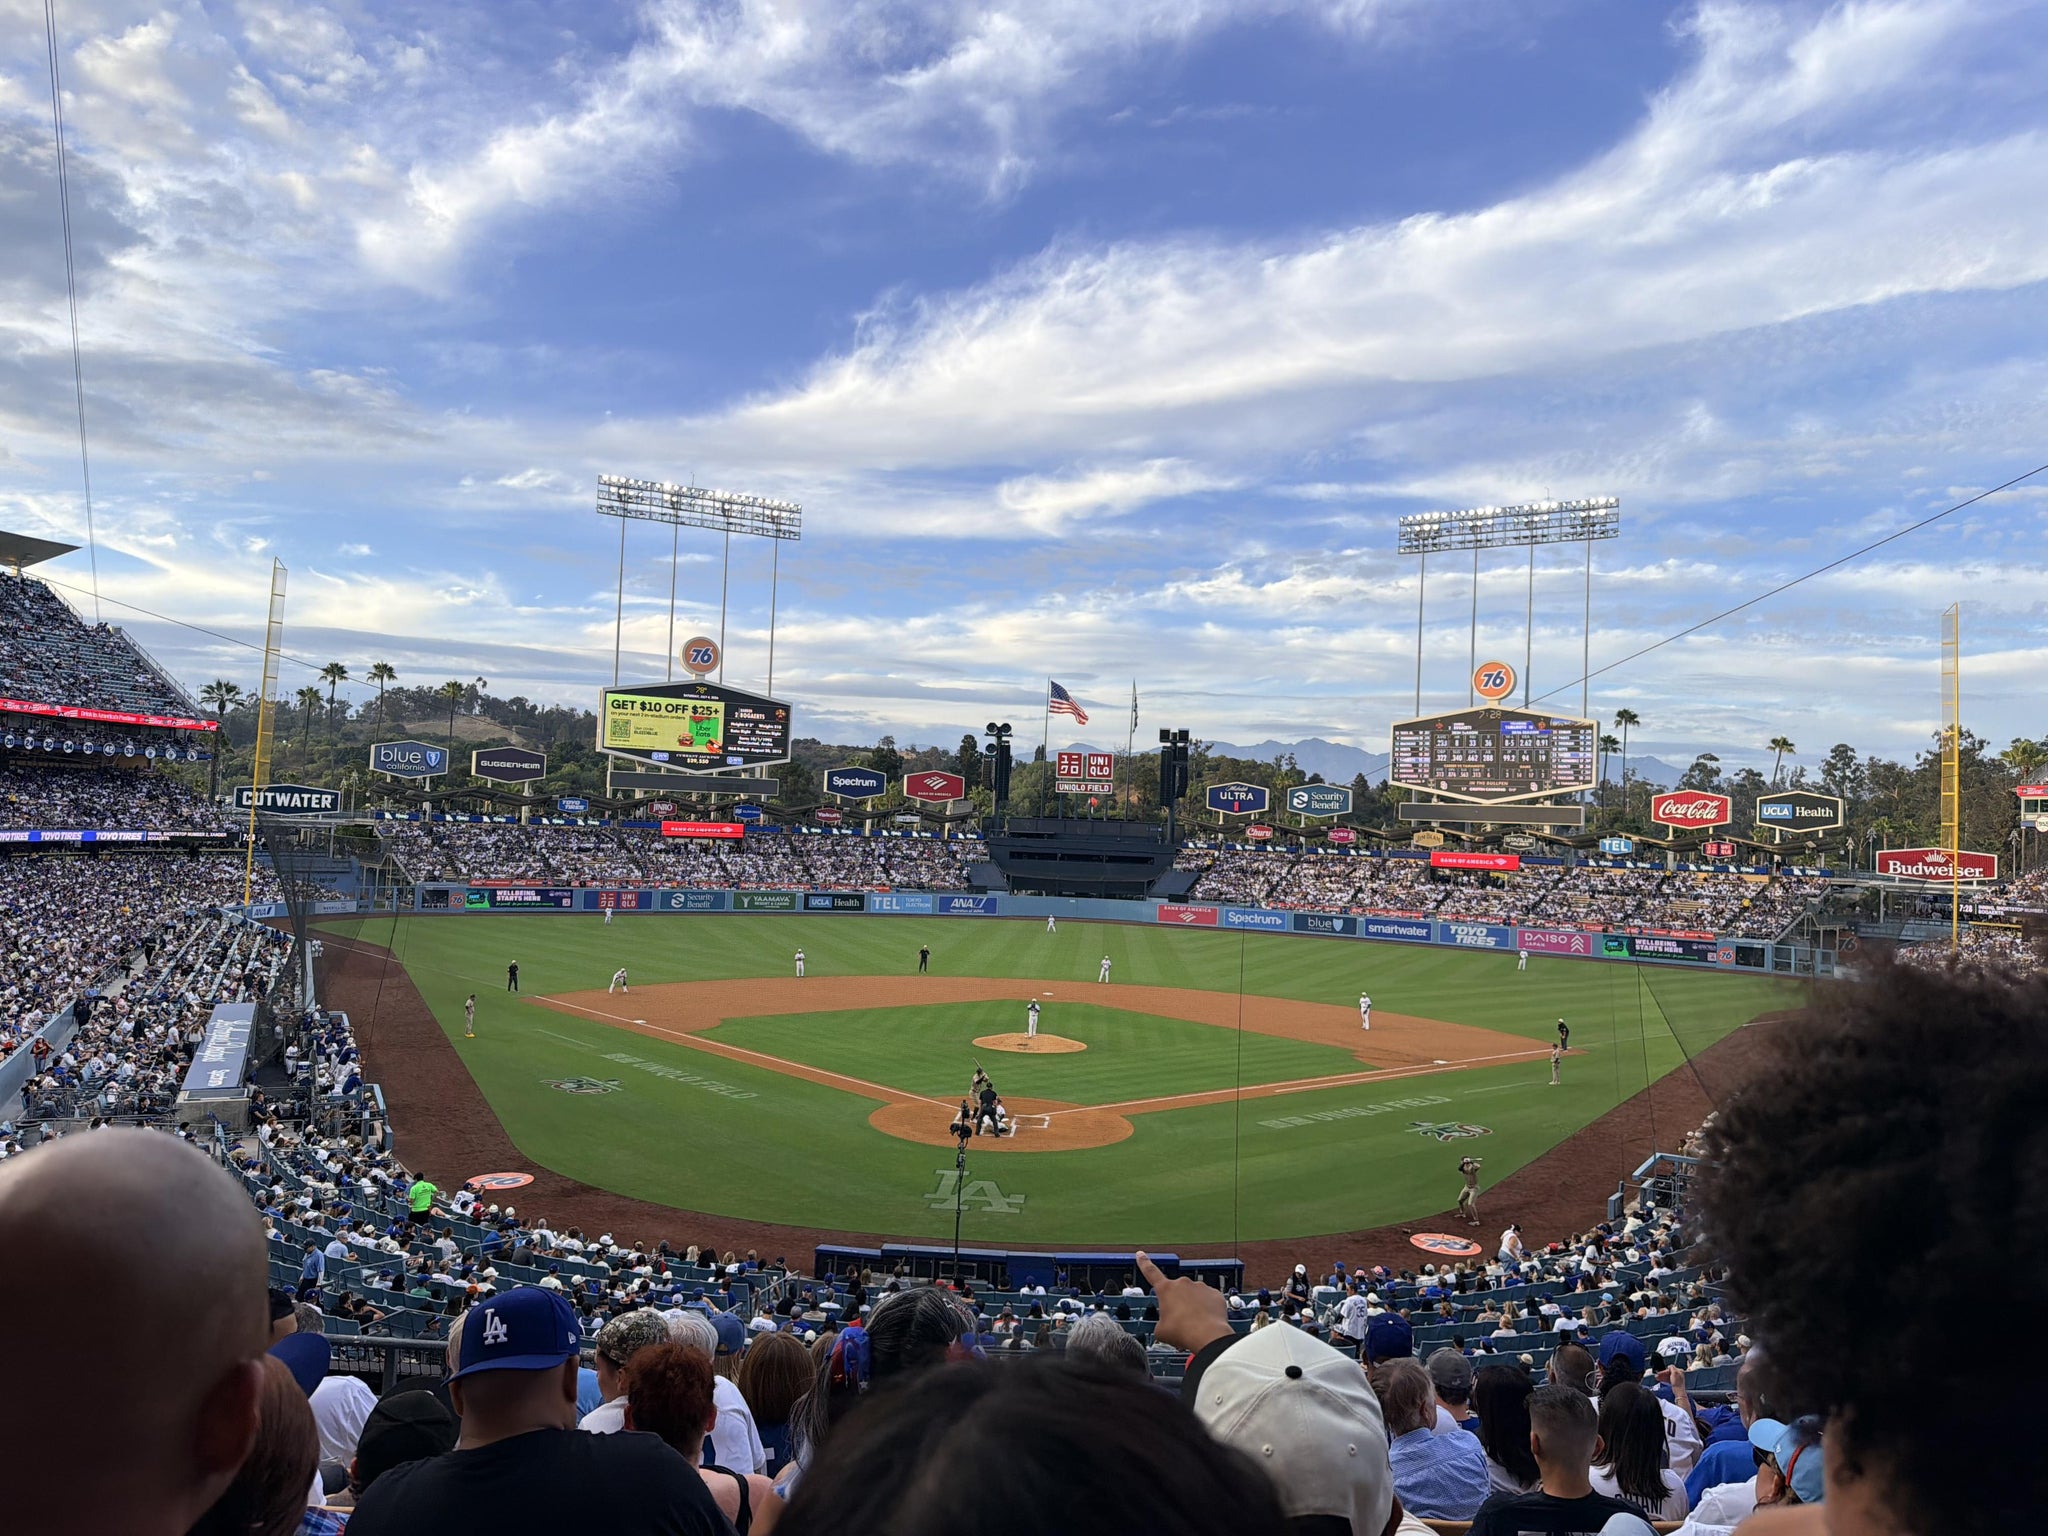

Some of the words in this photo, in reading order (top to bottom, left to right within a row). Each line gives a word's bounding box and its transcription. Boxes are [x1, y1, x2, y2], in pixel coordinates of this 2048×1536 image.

[690, 647, 713, 665] 76
[1480, 669, 1506, 689] 76
[612, 700, 636, 710] GET
[640, 701, 662, 712] $10
[665, 704, 688, 714] OFF
[692, 705, 719, 716] $25+
[1479, 710, 1501, 719] 7:28
[26, 738, 34, 747] 24
[105, 744, 114, 754] 42
[126, 747, 134, 755] 53
[380, 747, 422, 762] blue
[481, 760, 540, 769] GUGGENHEIM
[1091, 756, 1108, 765] UNI
[386, 762, 426, 772] california
[1090, 767, 1109, 776] QLO
[832, 776, 877, 788] Spectrum
[242, 791, 332, 808] CUTWATER
[1220, 792, 1254, 800] ULTRA
[1312, 792, 1344, 803] Security
[653, 803, 672, 812] JINRO
[1312, 801, 1341, 810] Benefit
[1659, 800, 1720, 820] Coca-Cola
[1763, 806, 1789, 816] UCLA
[1795, 807, 1834, 817] Health
[40, 832, 60, 841] TOYO
[60, 832, 82, 841] TIRES
[117, 832, 142, 840] TIRES
[1247, 828, 1272, 837] Churu
[1603, 841, 1628, 851] TEL
[451, 895, 463, 904] 76
[687, 894, 714, 902] Security
[834, 898, 859, 907] Health
[951, 898, 973, 908] ANA
[873, 898, 900, 909] TEL
[254, 908, 268, 917] ANA
[1228, 912, 1279, 926] Spectrum
[1308, 917, 1332, 928] blue
[1368, 924, 1428, 937] smartwater
[1450, 926, 1487, 936] TOYO
[1455, 935, 1496, 946] TIRES
[1525, 933, 1567, 944] DAISO
[1635, 939, 1677, 947] WELLBEING
[1635, 944, 1663, 952] STARTS
[1720, 951, 1733, 960] 76
[632, 1062, 703, 1082] UNIQLO
[700, 1080, 758, 1099] FIELD
[1307, 1104, 1393, 1122] UNIQLO
[1390, 1096, 1452, 1109] FIELD
[480, 1177, 523, 1185] 76
[924, 1170, 1025, 1214] LA
[455, 1195, 462, 1205] 8
[1420, 1238, 1473, 1252] 76
[1356, 1307, 1364, 1318] 35
[483, 1308, 508, 1345] LA
